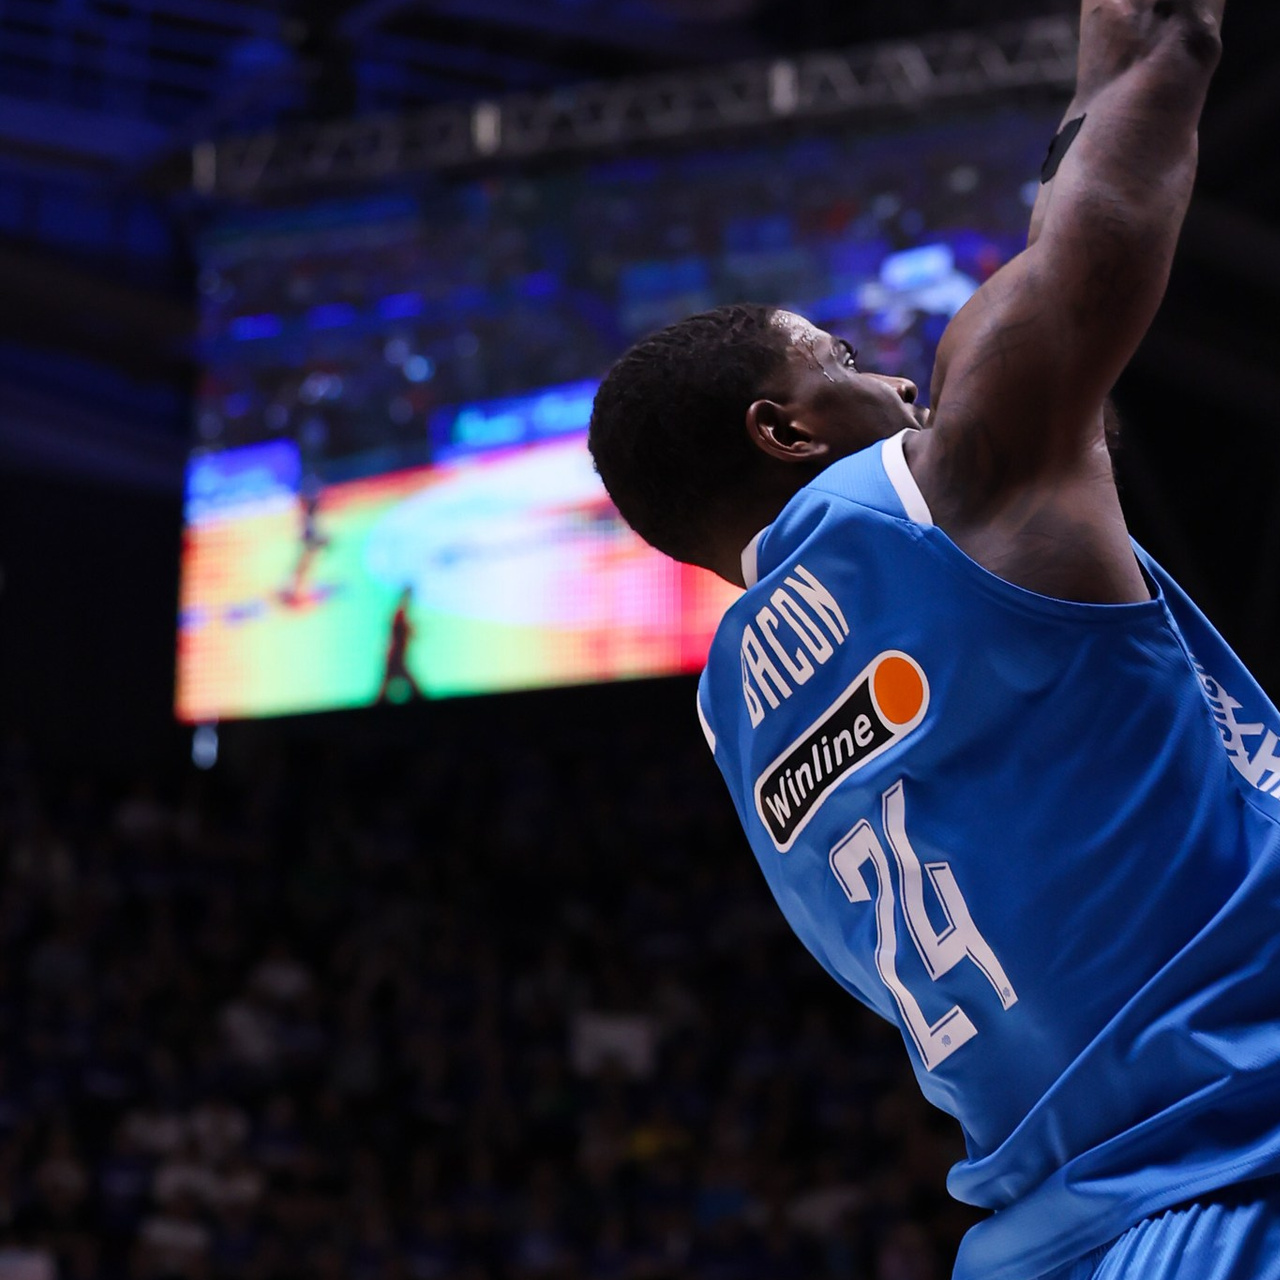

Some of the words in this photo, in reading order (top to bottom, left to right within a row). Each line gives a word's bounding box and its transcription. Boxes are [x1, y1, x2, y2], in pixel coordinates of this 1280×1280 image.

[741, 564, 849, 729] BACON
[766, 713, 875, 828] Winline
[829, 779, 1019, 1071] 24
